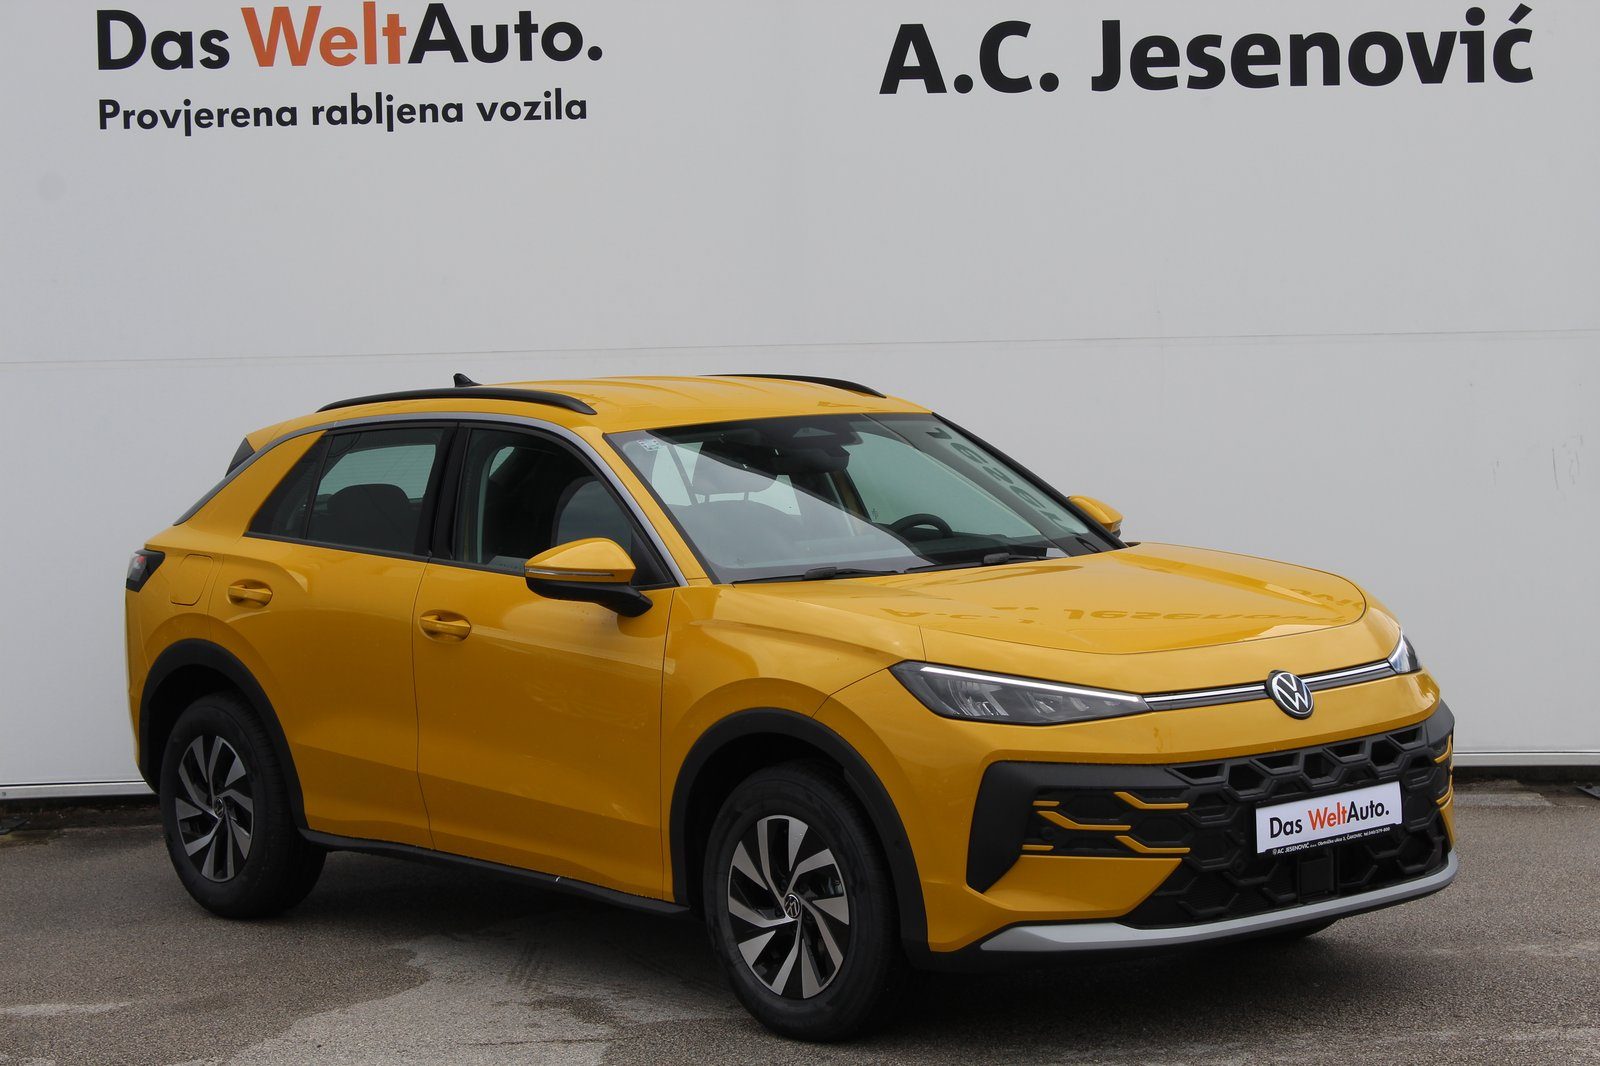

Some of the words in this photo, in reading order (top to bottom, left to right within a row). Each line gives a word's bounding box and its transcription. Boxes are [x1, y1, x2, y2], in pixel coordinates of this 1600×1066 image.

[97, 9, 230, 71] Das
[241, 1, 603, 67] WeltAuto.
[879, 20, 1060, 95] A.C.
[1091, 3, 1534, 92] Jesenović
[98, 98, 298, 137] Provjerena
[312, 92, 464, 133] rabljena
[476, 87, 587, 122] vozila
[1269, 816, 1303, 839] Das
[1307, 800, 1390, 831] WeltAuto.
